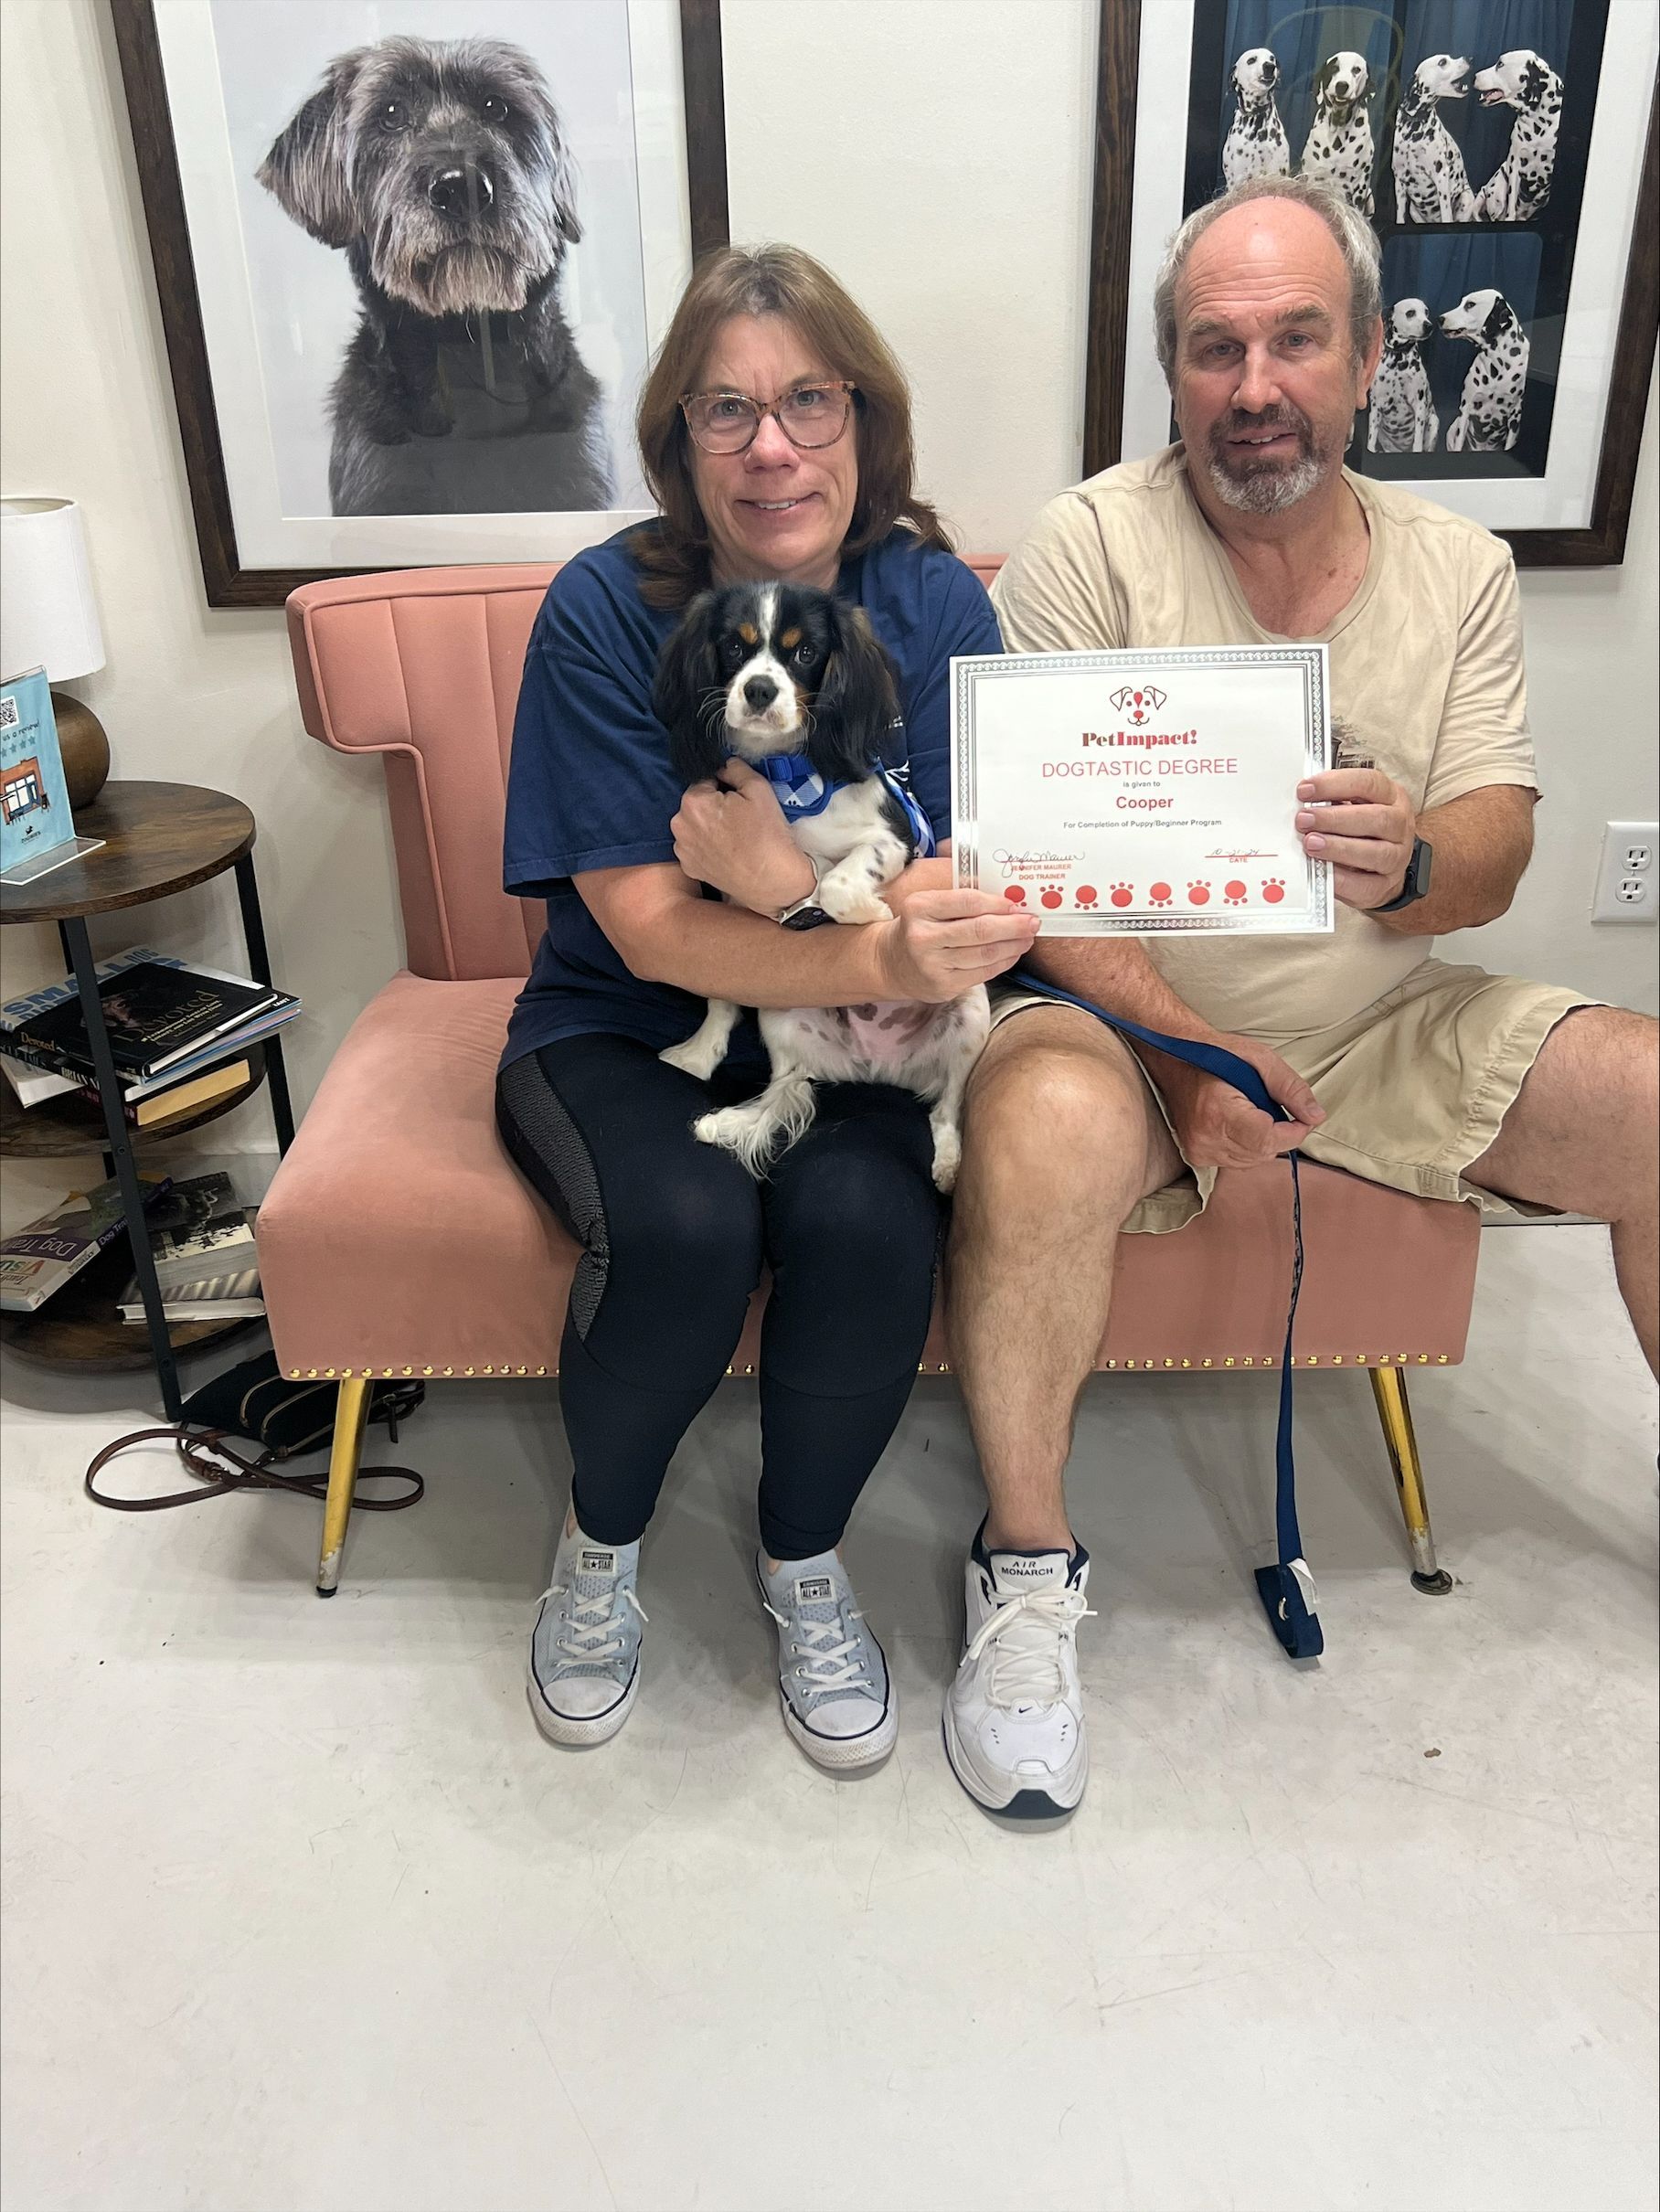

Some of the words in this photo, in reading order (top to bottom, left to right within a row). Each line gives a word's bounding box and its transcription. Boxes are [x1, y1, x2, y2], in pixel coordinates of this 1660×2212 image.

[1081, 729, 1197, 750] PetImpact!
[1042, 760, 1153, 778] DOGTASTIC
[1158, 758, 1239, 775] DEGREE
[1132, 782, 1152, 790] given
[1115, 796, 1175, 812] Cooper
[1078, 820, 1121, 829] Completion
[1121, 820, 1130, 828] of
[1130, 819, 1189, 829] Puppy/Beginner
[1190, 818, 1223, 828] Program
[112, 989, 220, 1042] Devoted
[21, 1031, 55, 1052] Devoted
[99, 1230, 115, 1245] Dog
[38, 1237, 78, 1257] Dog
[1, 1260, 45, 1273] VISU
[1001, 1567, 1053, 1576] MONARCH
